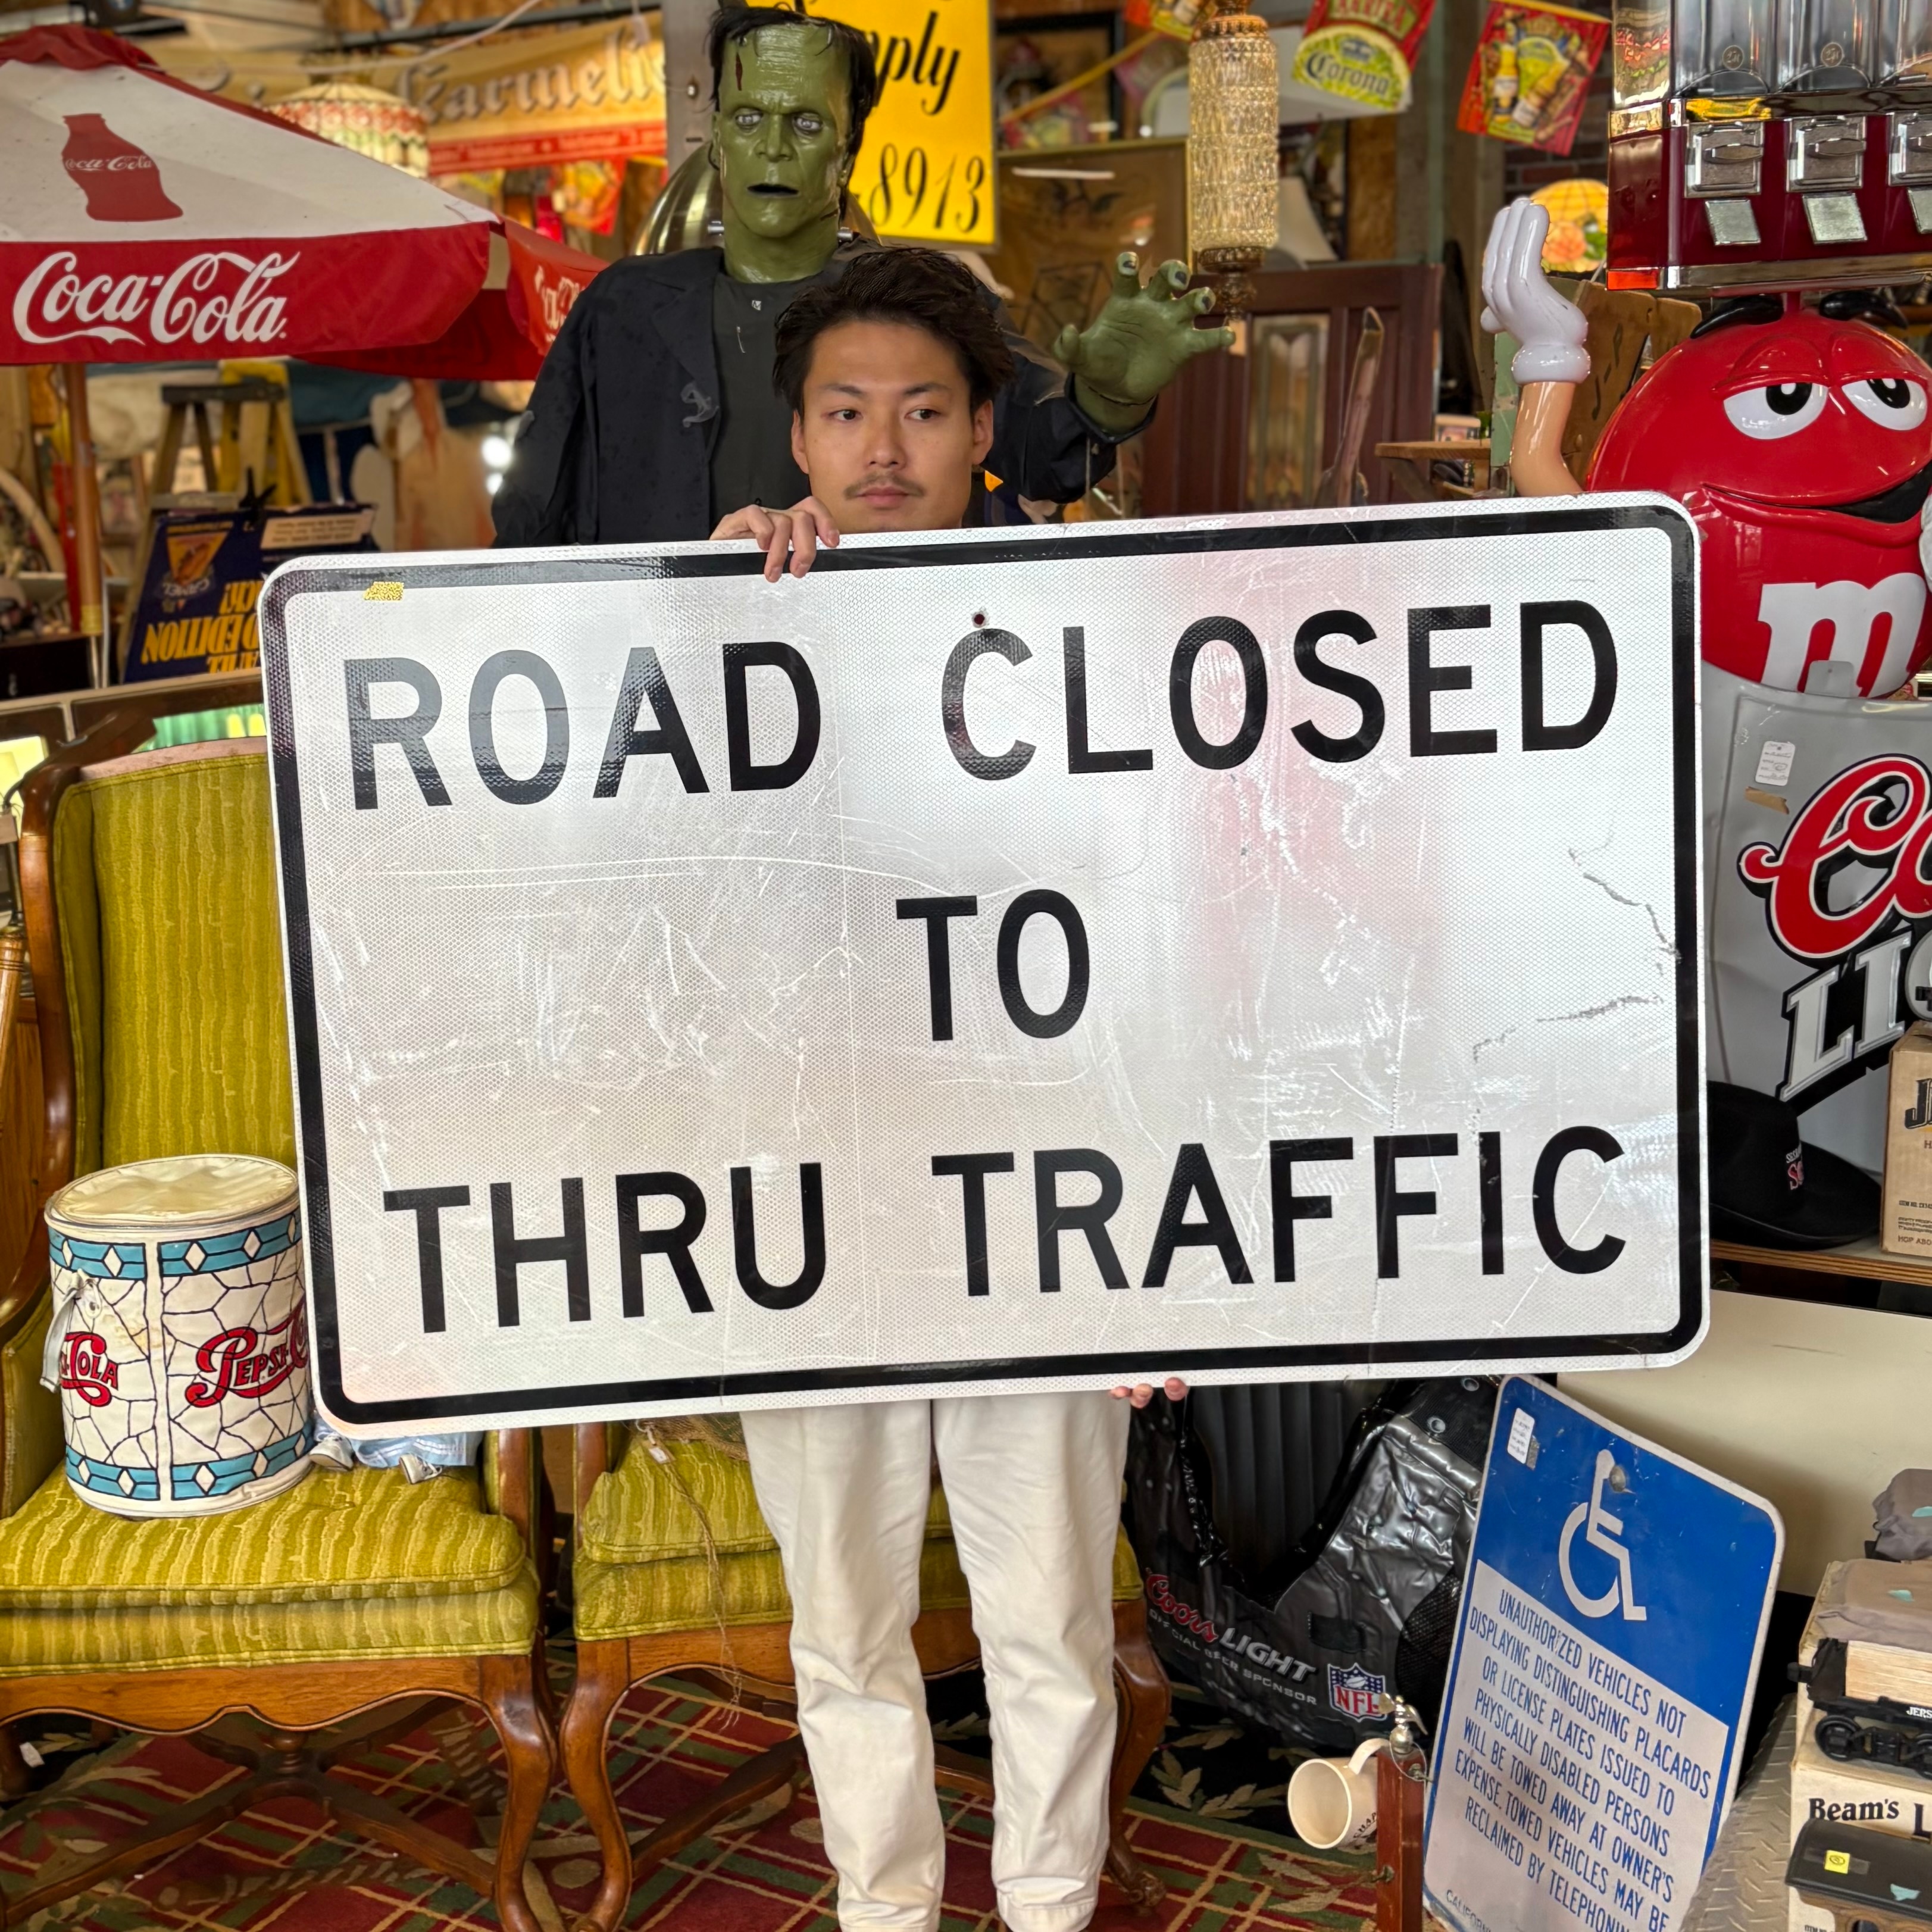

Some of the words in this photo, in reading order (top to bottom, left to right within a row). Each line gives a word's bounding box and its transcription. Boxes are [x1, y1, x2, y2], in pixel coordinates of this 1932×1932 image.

[1306, 51, 1390, 97] Corona
[65, 155, 152, 171] Coca-Cola
[13, 251, 300, 346] Coca-Cola
[346, 642, 821, 810] ROAD
[943, 601, 1615, 780] CLOSED
[896, 889, 1090, 1040] TO
[384, 1161, 824, 1333] THRU
[931, 1126, 1625, 1297] TRAFFIC
[1146, 1568, 1218, 1643] Coors
[1220, 1628, 1317, 1681] LIGHT
[1243, 1668, 1317, 1705] SPONSOR
[1499, 1589, 1582, 1669] UNAUTHORIZED
[1589, 1653, 1651, 1715] VEHICLES
[1656, 1699, 1687, 1739] NOT
[1336, 1685, 1379, 1715] NFL
[1470, 1606, 1530, 1671] DISPLAYING
[1534, 1655, 1630, 1743] DISTINGUISHING
[1635, 1726, 1711, 1799] PLACARDS
[1475, 1688, 1538, 1756] PHYSICALLY
[1540, 1741, 1600, 1805] DISABLED
[1605, 1789, 1670, 1856] PERSONS
[1483, 1656, 1498, 1686] OR
[1501, 1670, 1546, 1724] LICENSE
[1550, 1708, 1595, 1760] PLATES
[1600, 1744, 1650, 1798] ISSUED
[1657, 1781, 1674, 1816] TO
[1455, 1749, 1502, 1809] EXPENSE.
[1506, 1791, 1542, 1841] TOWED
[1548, 1826, 1608, 1895] VEHICLES
[1614, 1878, 1644, 1920] MAY
[1649, 1905, 1669, 1932] BE
[1464, 1717, 1486, 1756] WILL
[1491, 1740, 1506, 1771] BE
[1510, 1755, 1547, 1805] TOWED
[1550, 1792, 1586, 1834] AWAY
[1589, 1821, 1607, 1850] AT
[1612, 1836, 1673, 1902] OWNER'S
[1465, 1796, 1523, 1867] RECLAIMED
[1527, 1852, 1545, 1884] BY
[1809, 1797, 1899, 1821] Beam's
